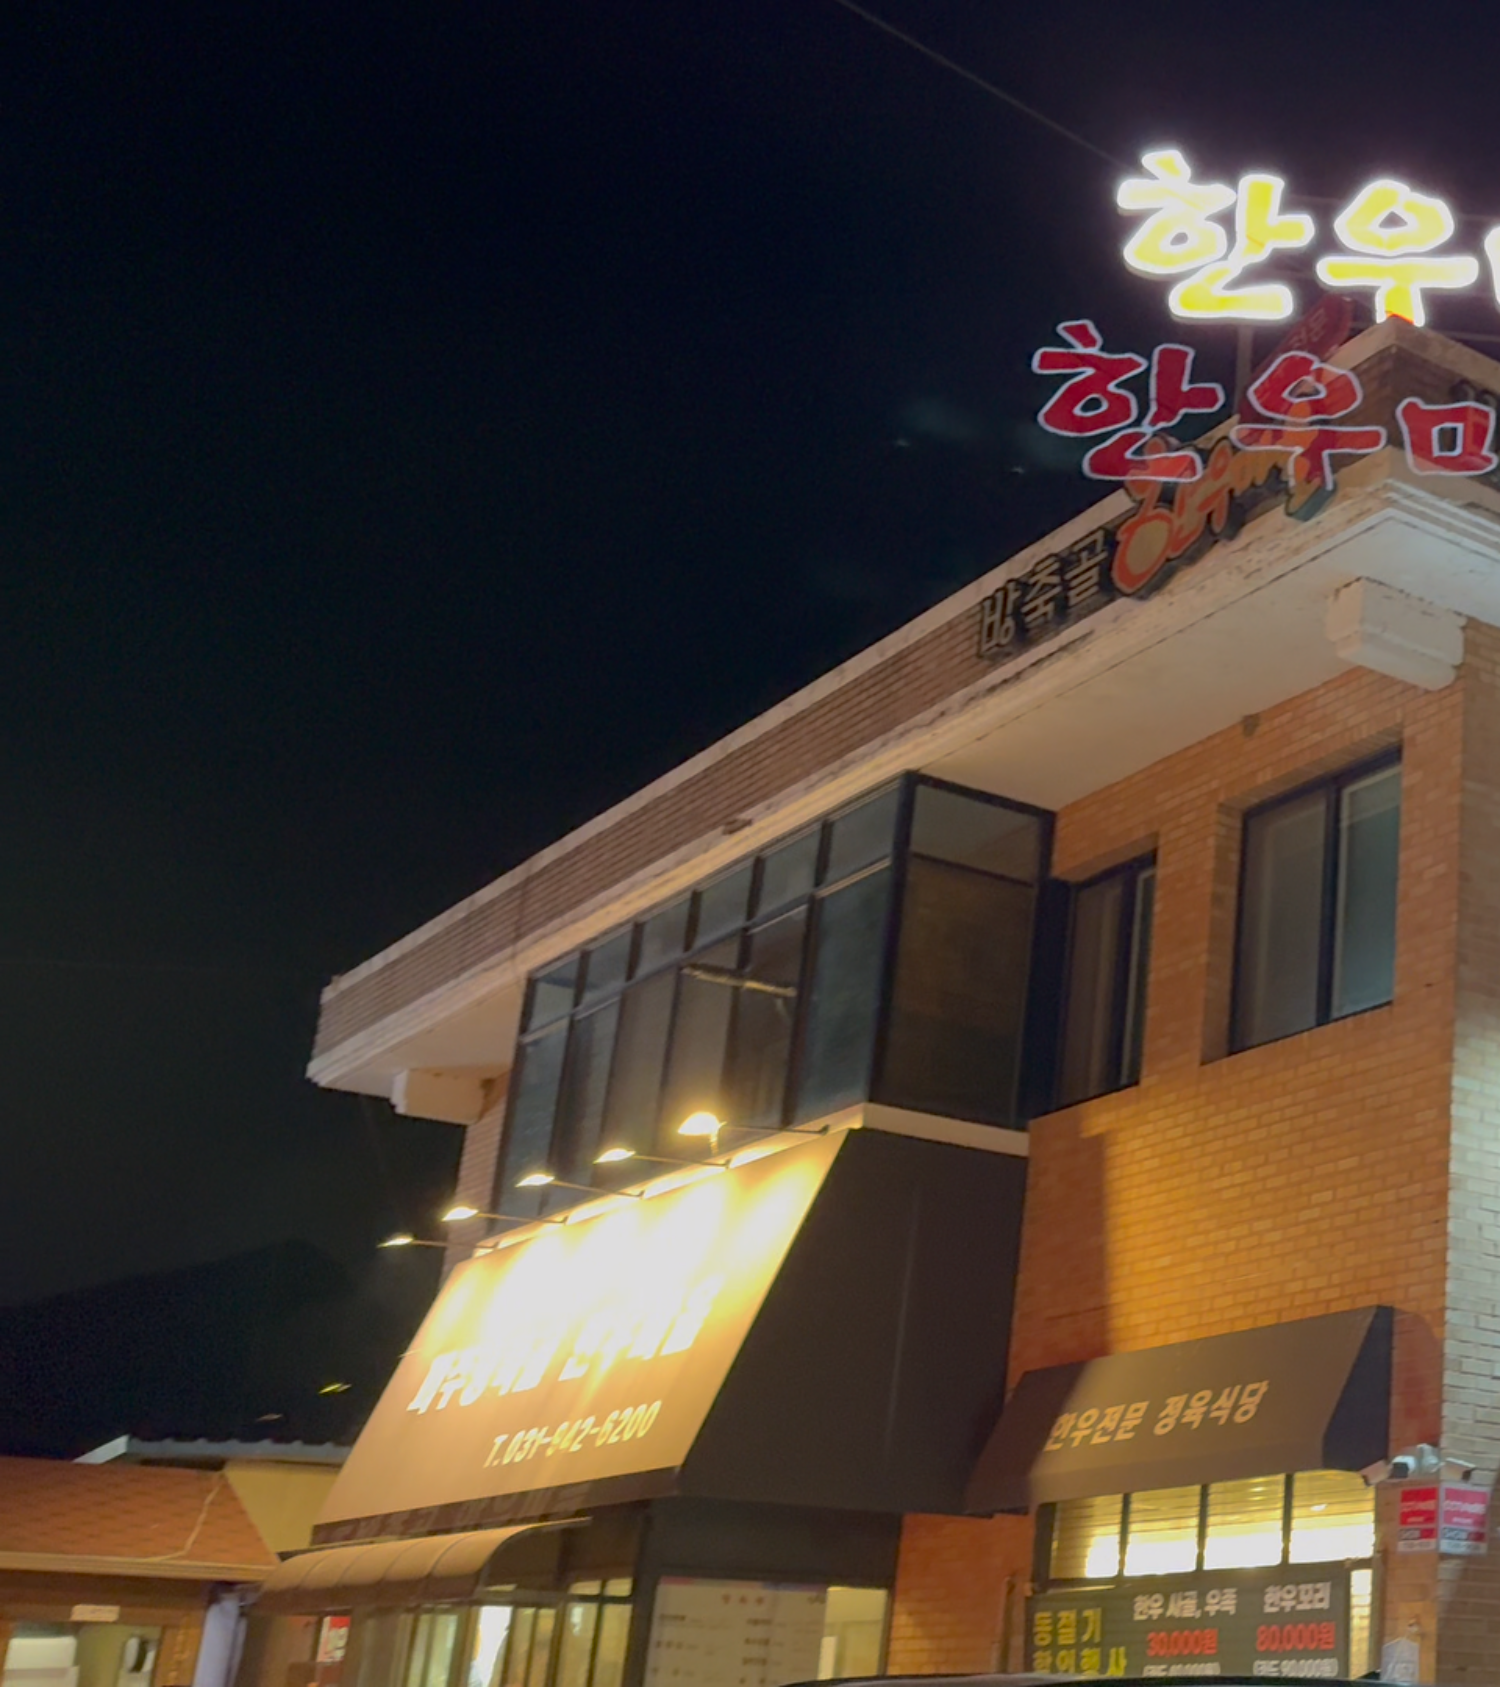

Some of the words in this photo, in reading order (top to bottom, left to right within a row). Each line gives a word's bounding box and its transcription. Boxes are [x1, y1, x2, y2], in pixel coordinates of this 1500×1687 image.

[1044, 1400, 1150, 1452] 한우전문
[1152, 1379, 1271, 1436] 정육식당
[1133, 1592, 1165, 1621] 한우
[1256, 1621, 1336, 1653] 80,000원
